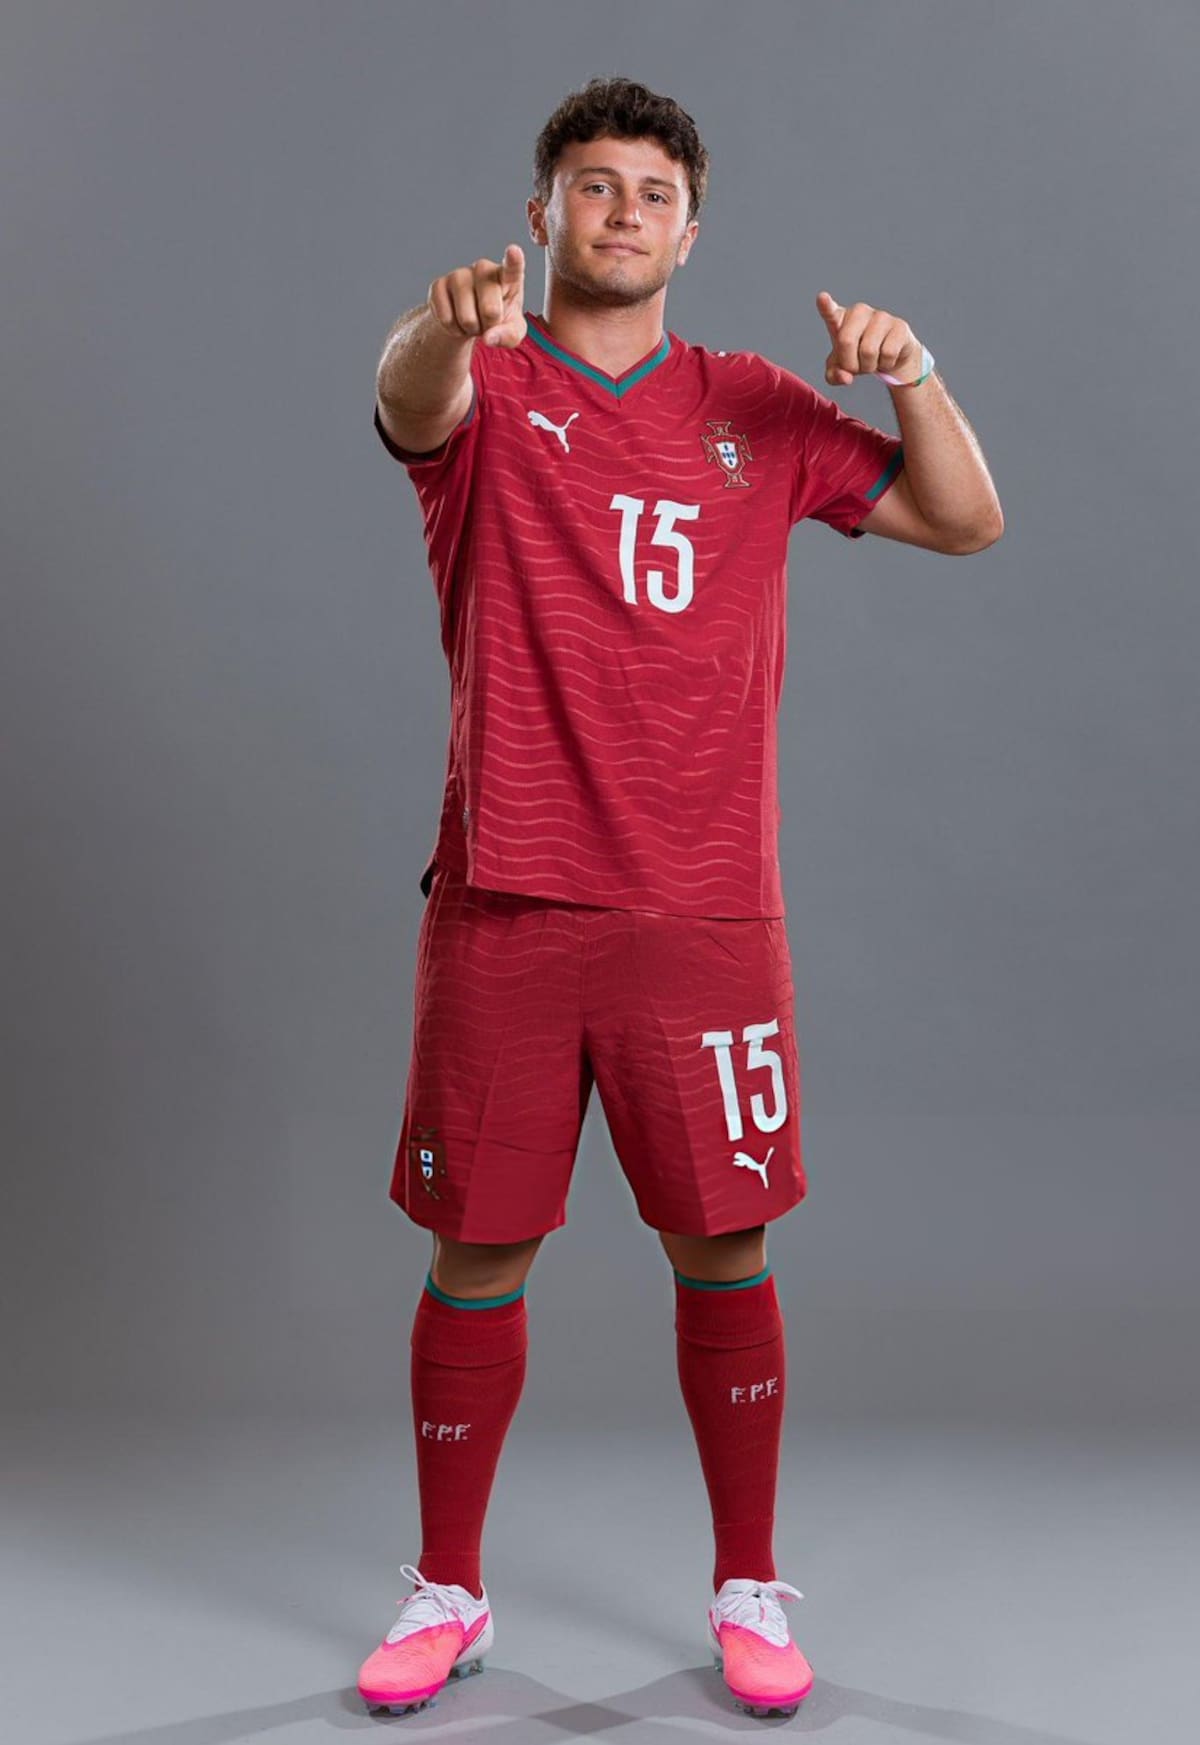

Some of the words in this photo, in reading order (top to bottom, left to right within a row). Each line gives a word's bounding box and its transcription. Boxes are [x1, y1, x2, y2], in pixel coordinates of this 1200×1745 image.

[609, 493, 700, 613] 15
[701, 1018, 788, 1141] 15
[731, 1376, 778, 1403] F.P.F.
